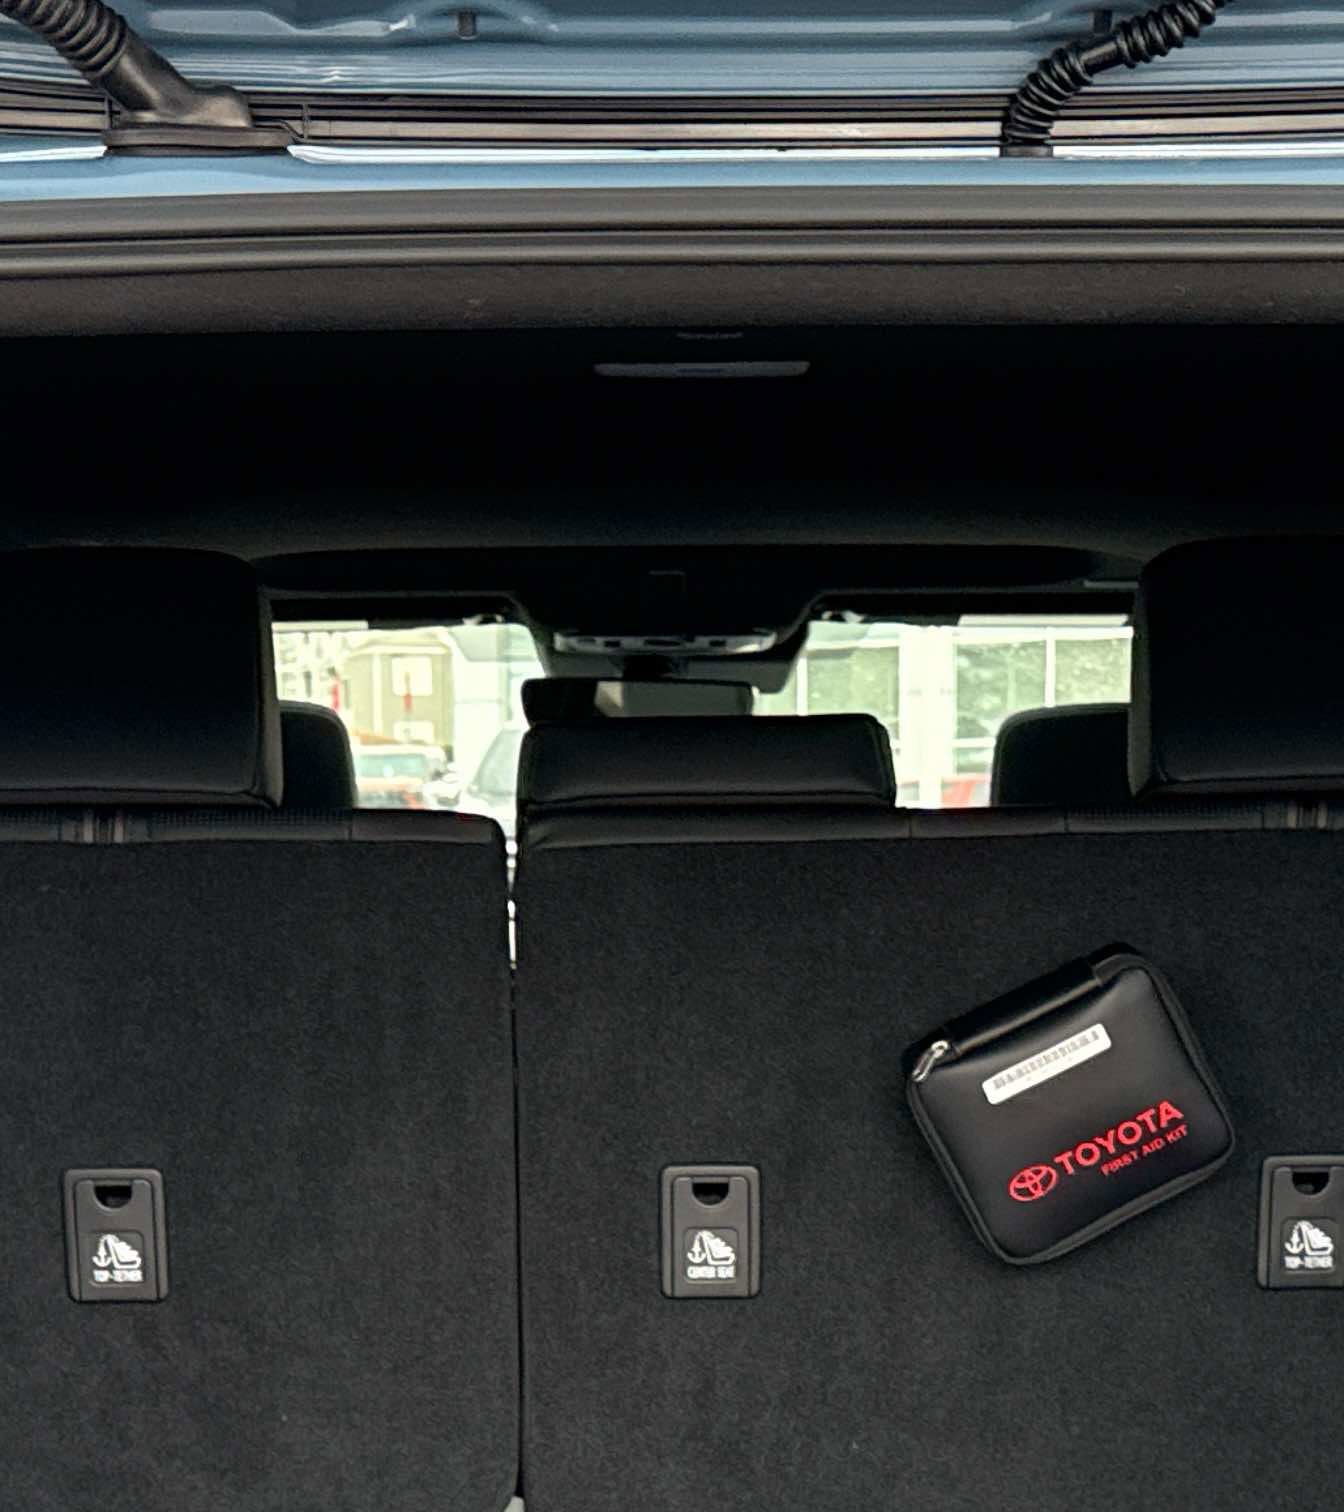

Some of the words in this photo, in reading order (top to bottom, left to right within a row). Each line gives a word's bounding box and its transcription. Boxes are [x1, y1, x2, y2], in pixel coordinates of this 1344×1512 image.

[1054, 1099, 1184, 1175] TOYOTA
[1100, 1150, 1137, 1176] FIRST
[1142, 1137, 1165, 1157] AID
[1166, 1123, 1188, 1144] KIT
